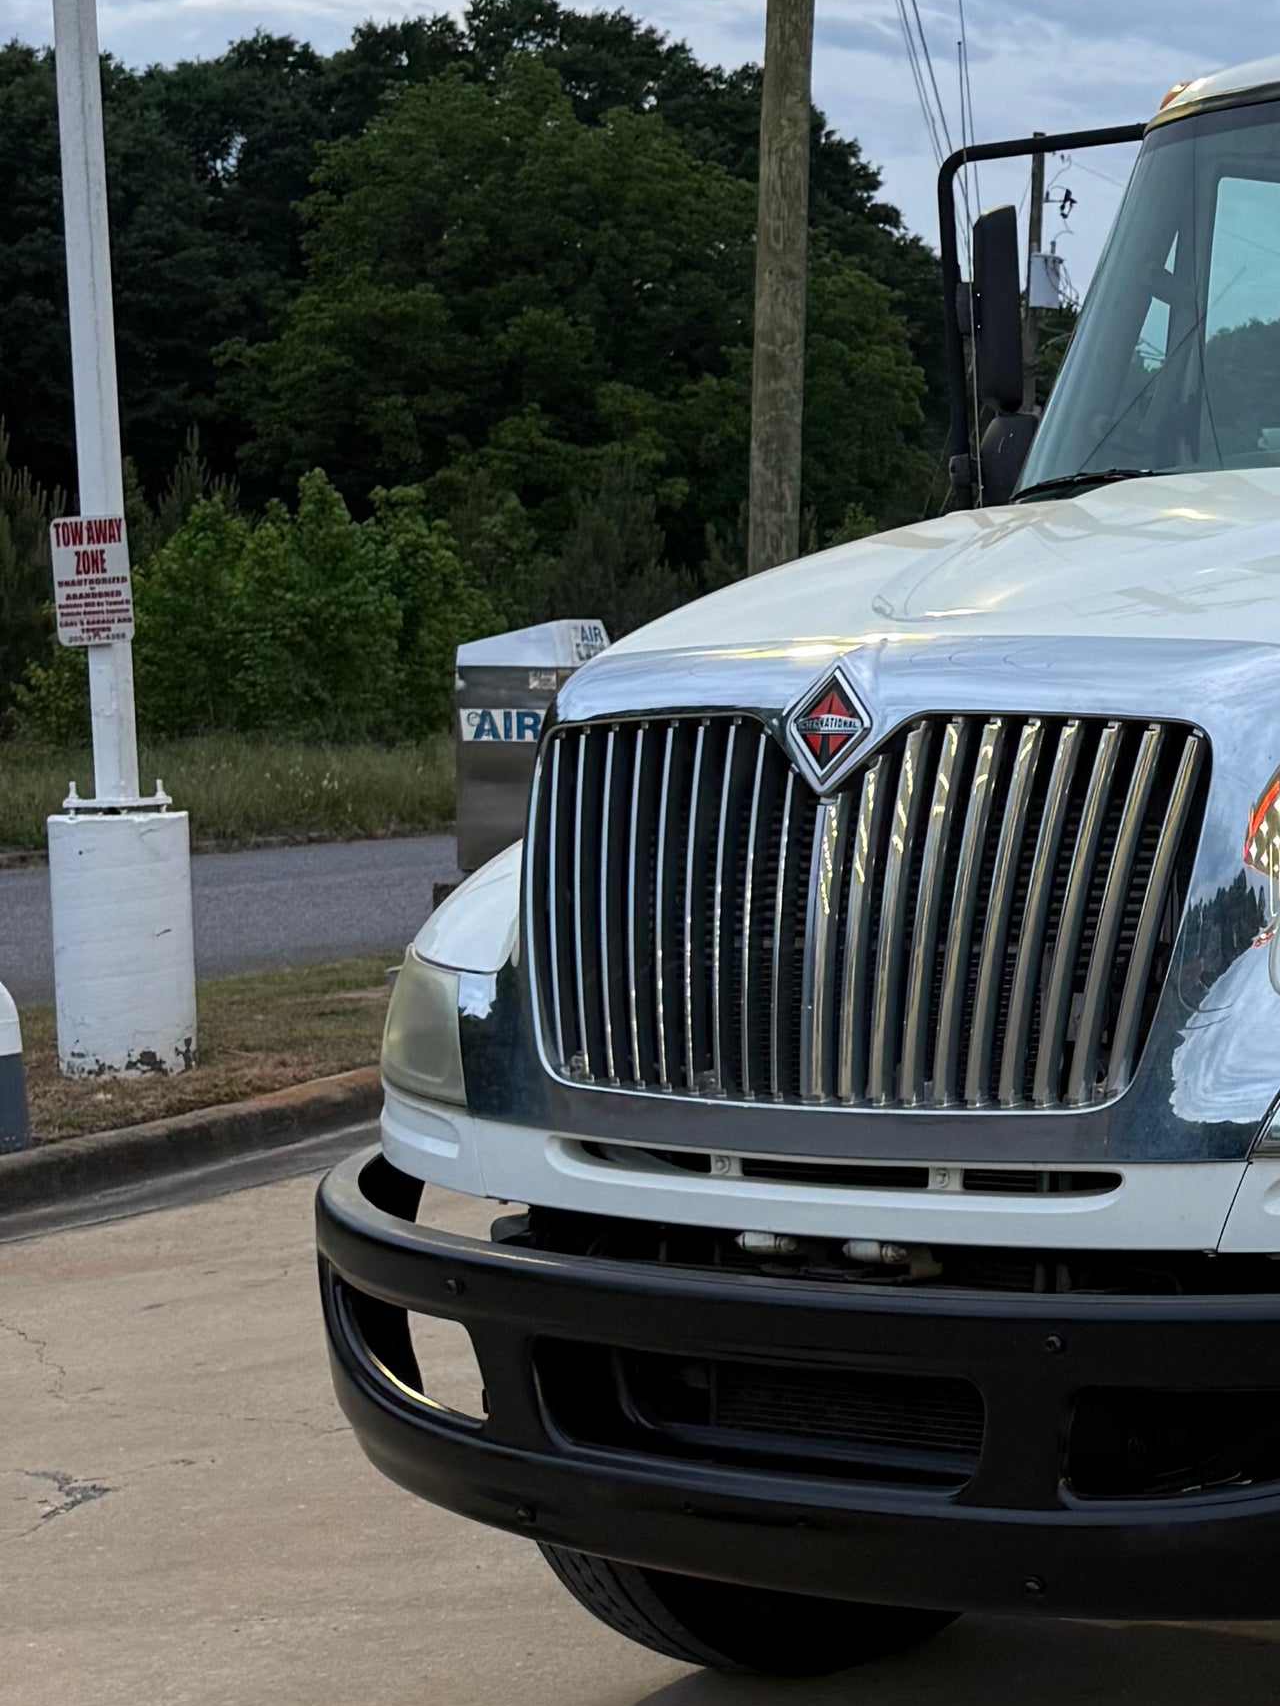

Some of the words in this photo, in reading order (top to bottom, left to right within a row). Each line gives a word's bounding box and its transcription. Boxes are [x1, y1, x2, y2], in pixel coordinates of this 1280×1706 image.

[53, 521, 84, 548] TOW
[86, 517, 122, 545] AWAY
[74, 549, 107, 576] ZONE
[57, 576, 128, 588] UNAUTHORIZED
[65, 590, 122, 601] ABANDONED
[580, 625, 604, 643] AIR
[473, 710, 541, 741] AIR
